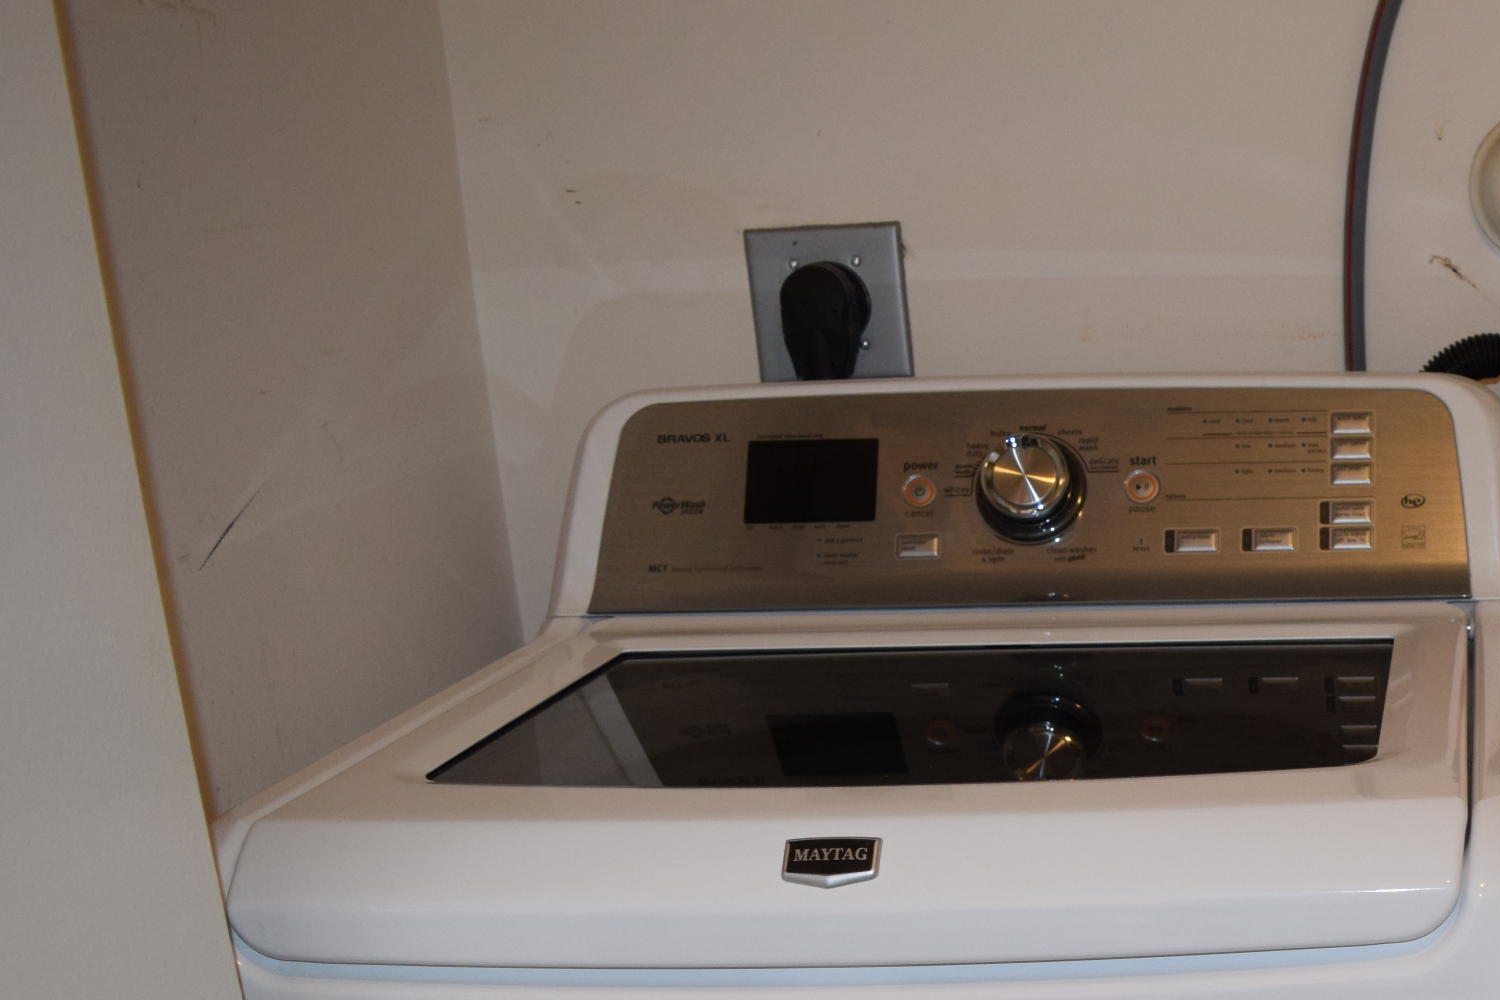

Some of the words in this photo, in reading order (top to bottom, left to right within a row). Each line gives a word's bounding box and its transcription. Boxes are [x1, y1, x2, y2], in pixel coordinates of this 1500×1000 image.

[656, 433, 711, 445] BRAVOS
[714, 433, 732, 443] XL
[1128, 455, 1157, 466] start
[903, 461, 940, 474] power
[905, 509, 934, 519] cancel
[1128, 505, 1156, 515] pause
[792, 847, 868, 862] MAYTAG
